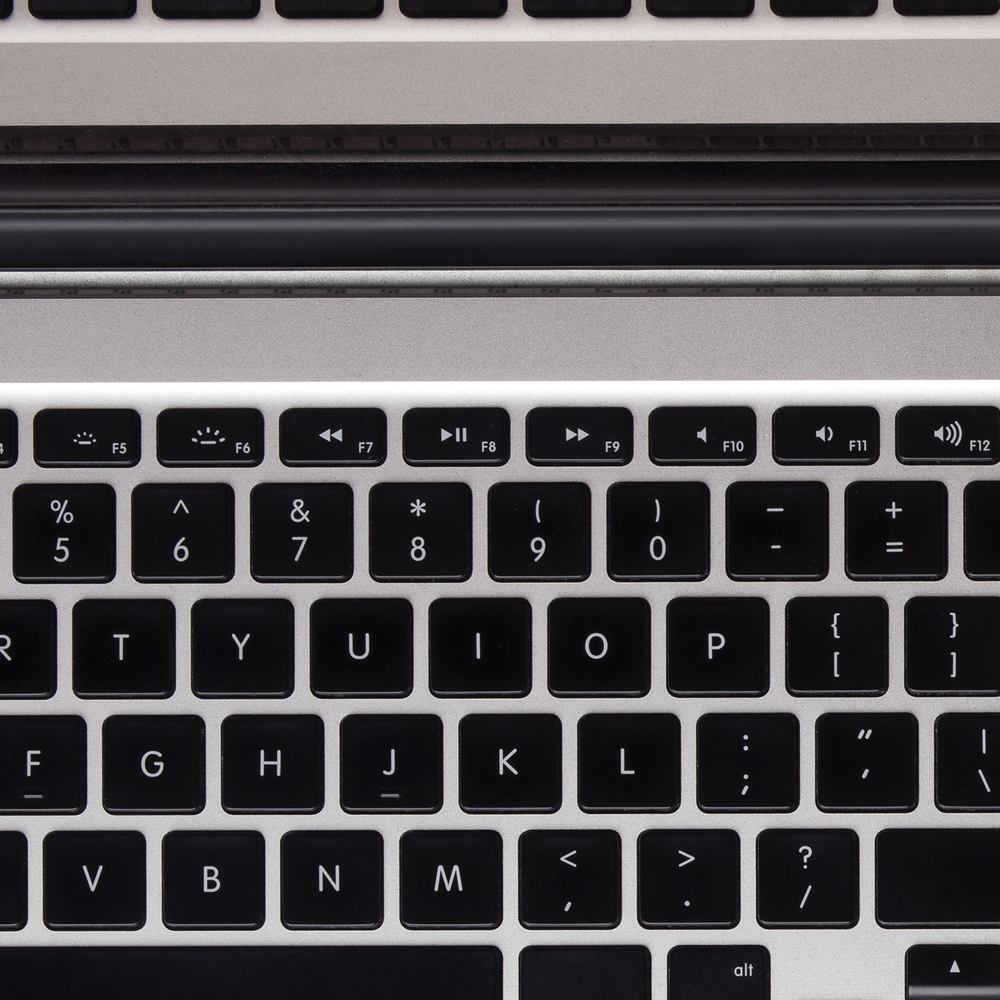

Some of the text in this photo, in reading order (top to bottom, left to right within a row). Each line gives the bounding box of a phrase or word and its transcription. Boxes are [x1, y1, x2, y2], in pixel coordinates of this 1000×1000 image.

[112, 442, 127, 455] F5
[235, 442, 251, 455] F6
[358, 441, 374, 454] F7
[481, 440, 497, 453] F8
[605, 440, 620, 453] F9
[722, 440, 745, 453] F10
[849, 439, 867, 452] F11
[969, 439, 991, 452] F12
[50, 499, 74, 524] %
[290, 498, 310, 523] &
[535, 499, 542, 524] (
[654, 498, 661, 523] )
[884, 501, 903, 519] +
[53, 537, 70, 563] 5
[173, 536, 190, 562] 6
[291, 536, 308, 562] 7
[410, 536, 427, 562] 8
[530, 536, 546, 562] 9
[649, 535, 667, 561] 0
[885, 541, 904, 553] =
[830, 612, 841, 639] {
[949, 612, 960, 639] }
[0, 634, 12, 662] R
[112, 633, 130, 661] T
[231, 633, 251, 661] Y
[348, 632, 370, 660] U
[475, 632, 481, 660] I
[584, 632, 609, 660] O
[707, 632, 726, 660] P
[833, 651, 840, 678] [
[950, 651, 957, 678] ]
[742, 734, 749, 752] :
[26, 749, 42, 777] F
[140, 750, 165, 778] G
[259, 749, 282, 777] H
[382, 748, 396, 776] J
[498, 748, 519, 776] K
[620, 747, 636, 775] L
[741, 773, 749, 796] ;
[559, 850, 577, 868] <
[677, 849, 696, 868] >
[798, 845, 813, 876] ?
[82, 864, 104, 893] V
[203, 865, 221, 893] B
[318, 864, 340, 892] N
[433, 864, 463, 892] M
[799, 884, 812, 909] /
[733, 962, 754, 977] alt
